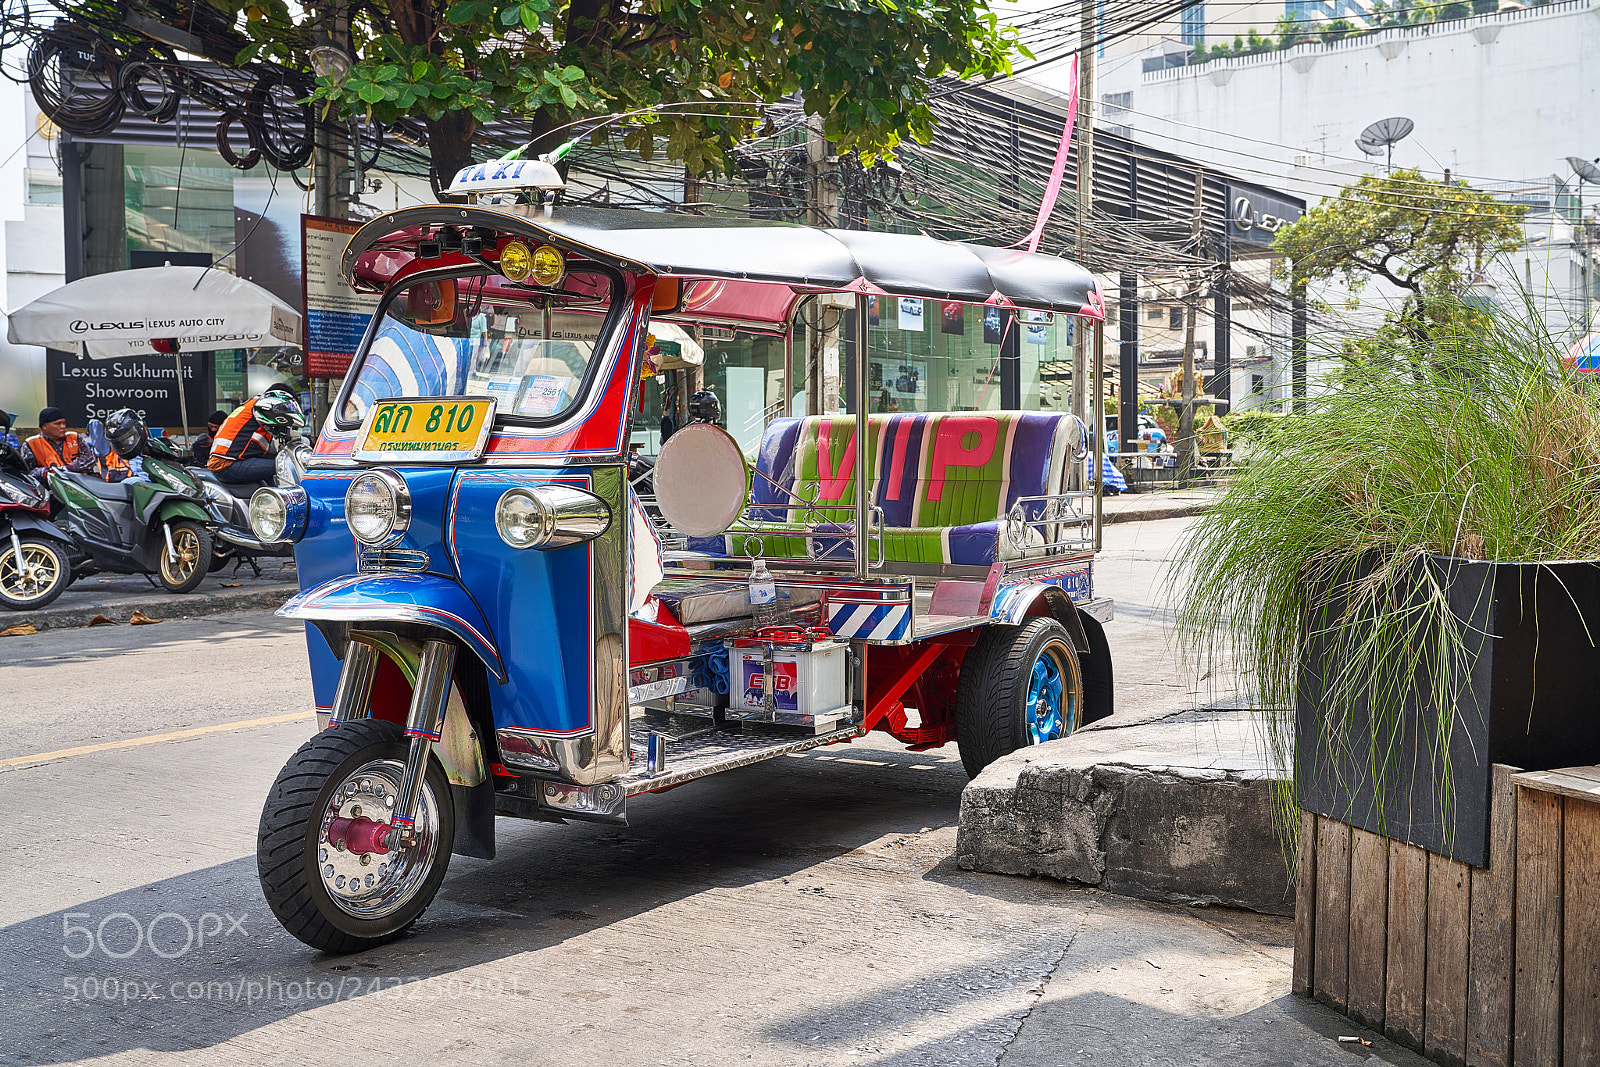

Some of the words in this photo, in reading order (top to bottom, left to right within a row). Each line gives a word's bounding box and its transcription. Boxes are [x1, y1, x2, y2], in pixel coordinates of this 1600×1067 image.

[77, 50, 95, 62] TUC
[460, 161, 527, 182] TAXI
[90, 321, 144, 330] LEXUS
[148, 320, 176, 328] LEXUS
[179, 319, 203, 327] AUTO
[206, 318, 225, 326] CITY
[564, 331, 582, 340] LEXUS
[61, 362, 108, 378] Lexus
[85, 382, 168, 399] Showroom
[85, 403, 147, 419] Sere
[374, 403, 414, 433] สก
[425, 403, 475, 433] 810
[379, 441, 460, 451] กรงเทพมหานคร
[817, 416, 999, 501] VIP
[749, 673, 791, 691] EB
